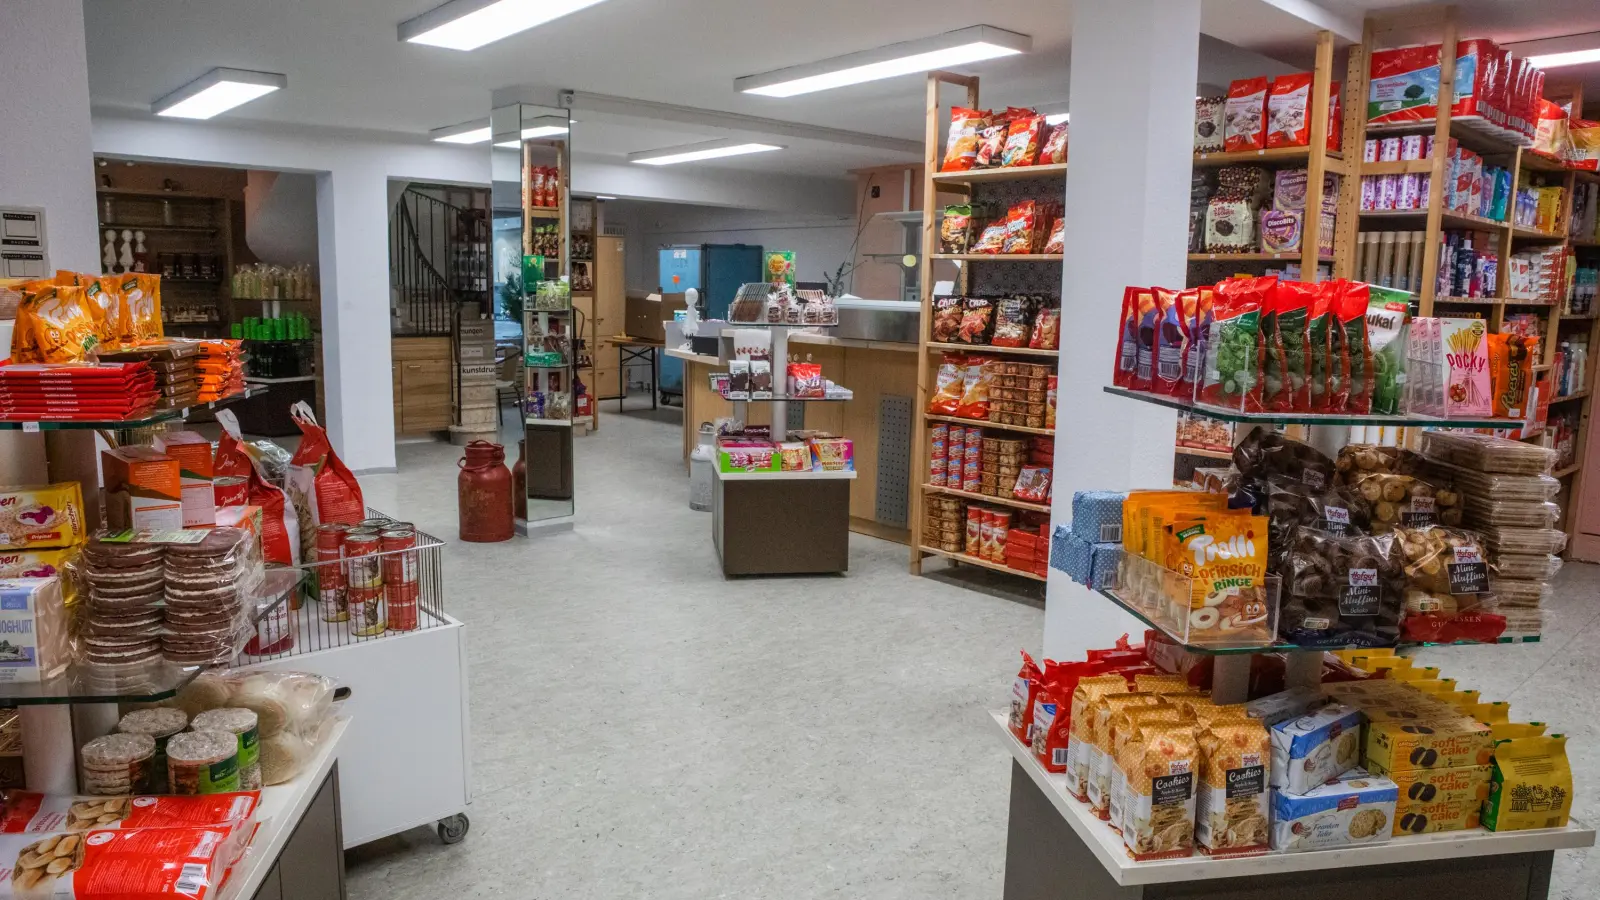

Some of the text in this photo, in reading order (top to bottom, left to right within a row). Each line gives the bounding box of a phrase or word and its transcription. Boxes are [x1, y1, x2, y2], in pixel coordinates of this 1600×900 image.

[1267, 217, 1295, 227] DiscoBits
[1502, 359, 1519, 410] Reese's
[1327, 507, 1348, 519] Hofgut
[1455, 548, 1478, 558] Hofgut
[1453, 563, 1478, 574] Mini-
[1350, 571, 1377, 581] Hofgut
[1451, 571, 1486, 584] Muffins
[1213, 578, 1253, 592] RINGE
[1346, 586, 1372, 596] Mini-
[1341, 595, 1379, 606] Muffins
[0, 619, 33, 634] OGHURT
[1431, 736, 1456, 749] soft
[1440, 745, 1470, 756] cake
[1229, 769, 1262, 783] Cookies
[1430, 772, 1456, 784] soft
[1155, 777, 1190, 790] Cookies
[1439, 780, 1470, 791] cake
[1420, 802, 1449, 814] soft
[1430, 810, 1460, 821] cake
[1312, 822, 1340, 831] Franken
